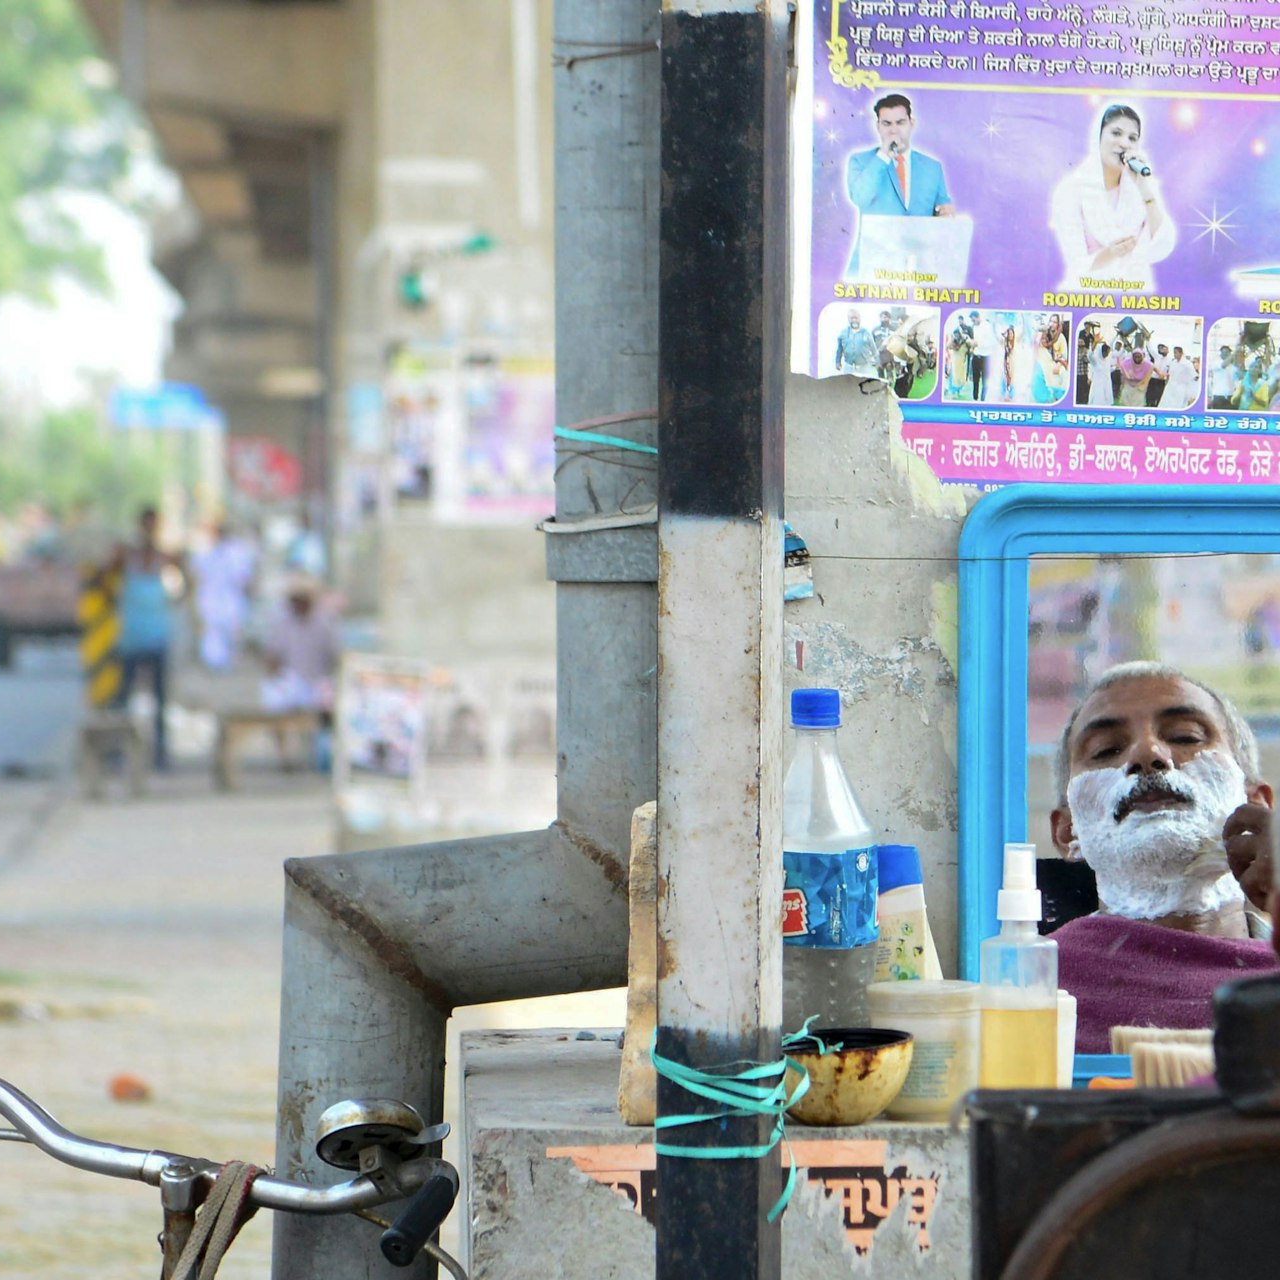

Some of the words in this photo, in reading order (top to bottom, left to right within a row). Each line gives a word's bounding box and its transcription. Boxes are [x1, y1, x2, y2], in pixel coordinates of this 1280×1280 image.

[908, 24, 926, 43] ਦੀ
[1026, 33, 1055, 48] ਨਾਲ
[1232, 41, 1266, 55] ਕਰਨ
[885, 53, 906, 68] ਆ
[908, 51, 944, 69] ਸਕਦੇ
[983, 53, 1011, 72] ਜਿਸ
[1074, 57, 1088, 74] ਦੇ
[1262, 67, 1279, 81] ਦਾ
[874, 268, 938, 283] Worshiper
[1079, 276, 1145, 291] Worshiper
[833, 283, 908, 301] SATNAM
[913, 288, 982, 304] BHATTI
[1042, 291, 1115, 310] ROMIKA
[1121, 295, 1182, 312] MASIH
[952, 430, 1001, 466] ਰਣਜੀਤ
[1144, 436, 1212, 475] ਏਅਰਪੋਰਟ
